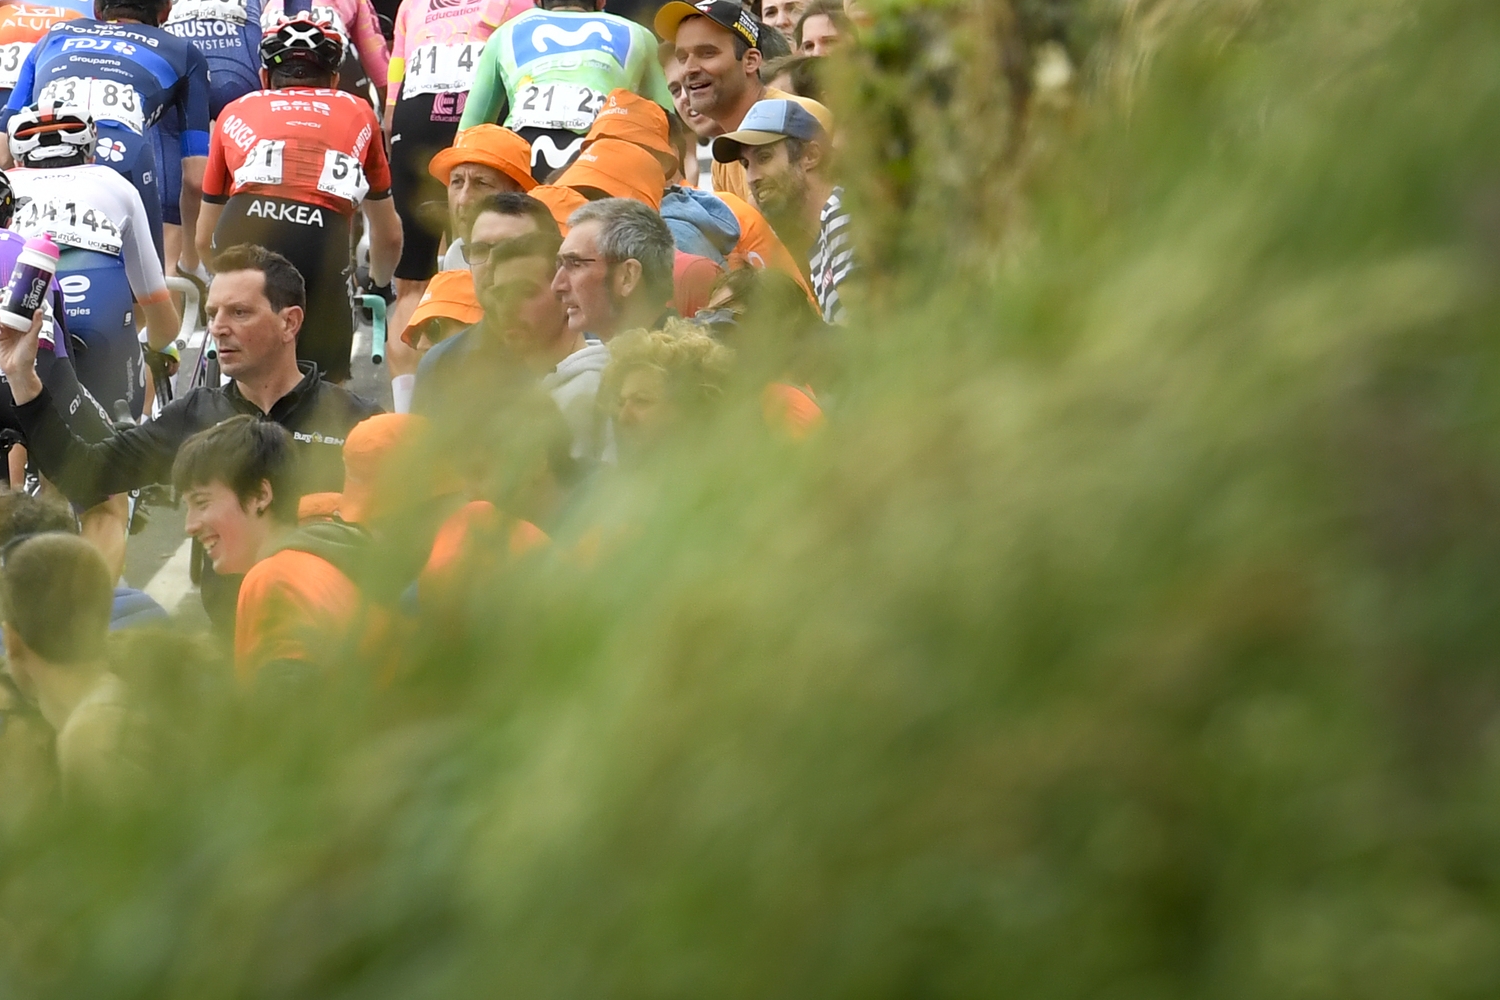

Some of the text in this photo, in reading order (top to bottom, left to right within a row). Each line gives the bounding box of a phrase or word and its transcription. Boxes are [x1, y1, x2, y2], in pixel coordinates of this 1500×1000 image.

[424, 5, 481, 24] Education
[50, 21, 160, 48] Groupama
[61, 37, 112, 52] FDJ
[192, 37, 242, 50] SYSTEMS
[69, 55, 121, 67] Groupama
[102, 84, 136, 113] 83
[522, 86, 556, 112] 21
[247, 200, 325, 228] ARKEA
